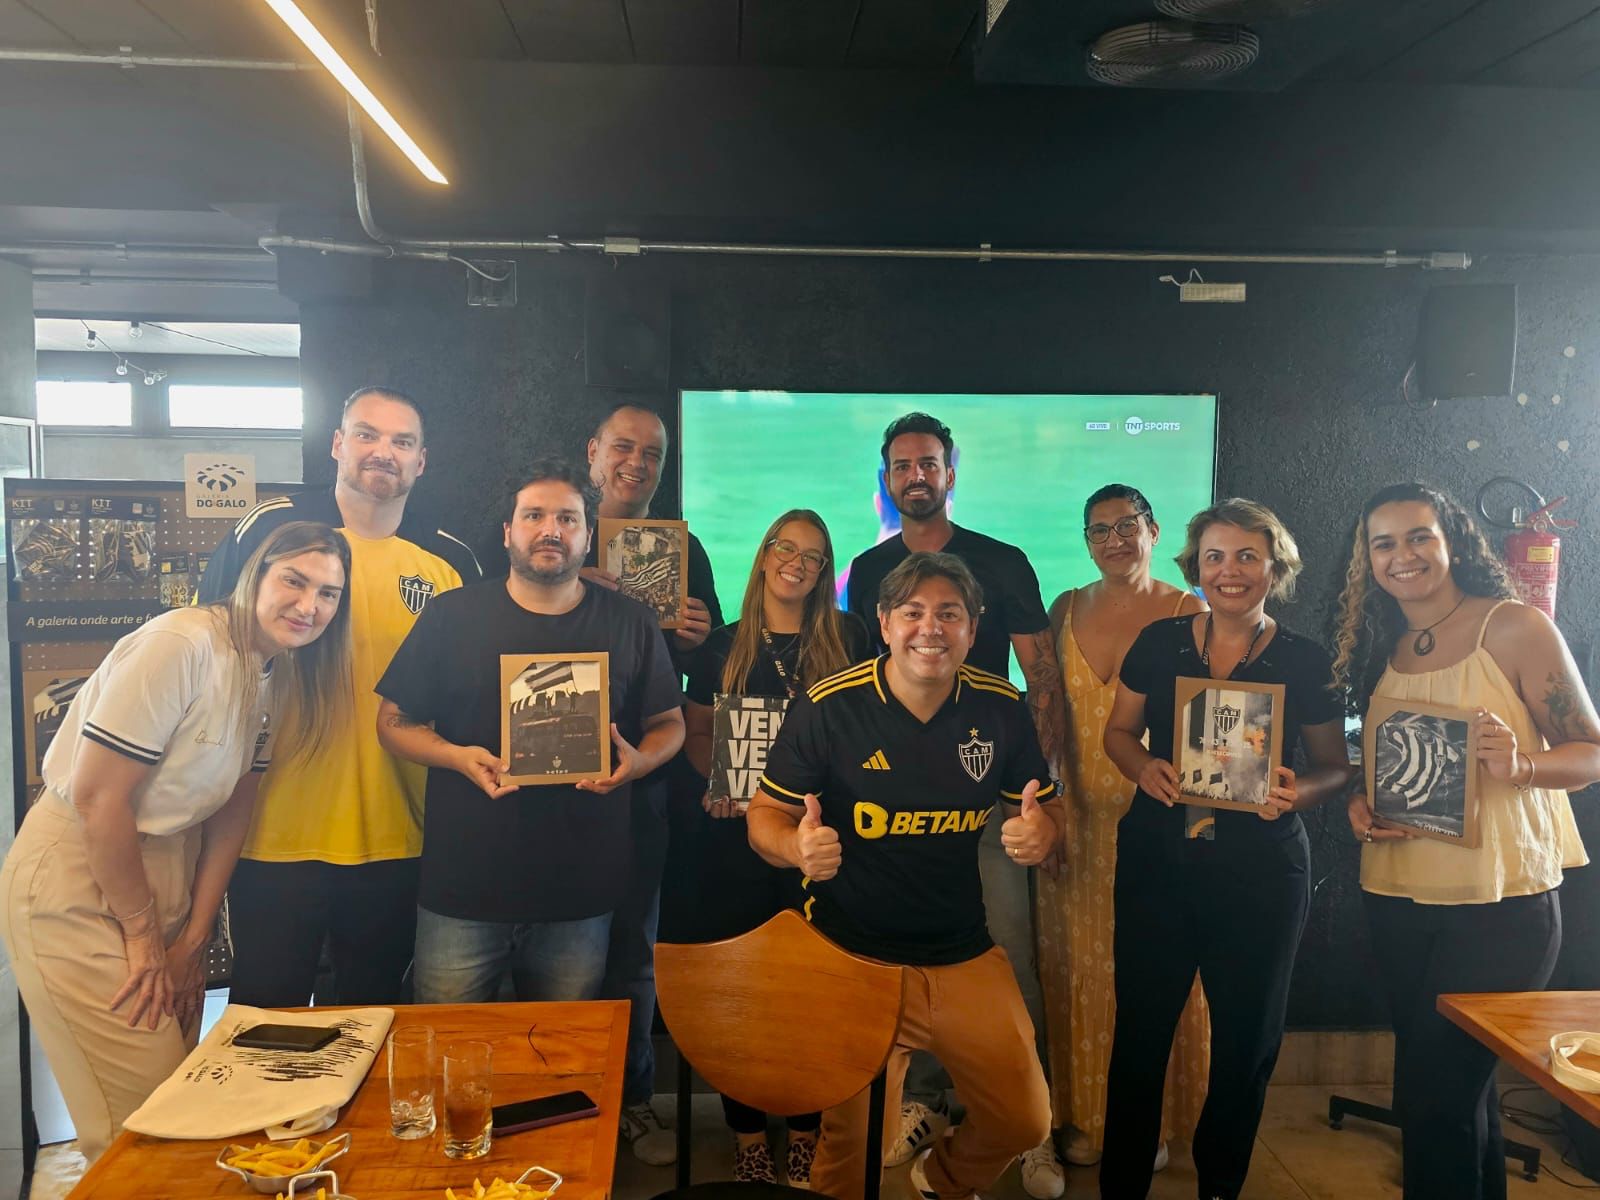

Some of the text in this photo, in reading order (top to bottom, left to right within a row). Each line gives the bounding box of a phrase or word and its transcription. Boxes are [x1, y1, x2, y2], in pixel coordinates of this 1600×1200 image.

[1126, 422, 1181, 431] TNT SPORTS
[12, 499, 33, 508] KIT
[91, 499, 112, 507] KIT
[216, 499, 247, 508] GALO
[404, 580, 431, 592] CAM
[25, 616, 35, 626] A
[36, 615, 77, 629] galeria
[79, 614, 109, 625] onde
[110, 615, 134, 625] arte
[136, 616, 143, 624] e
[774, 660, 786, 677] GALO
[727, 739, 775, 769] VE
[964, 746, 989, 755] CAM
